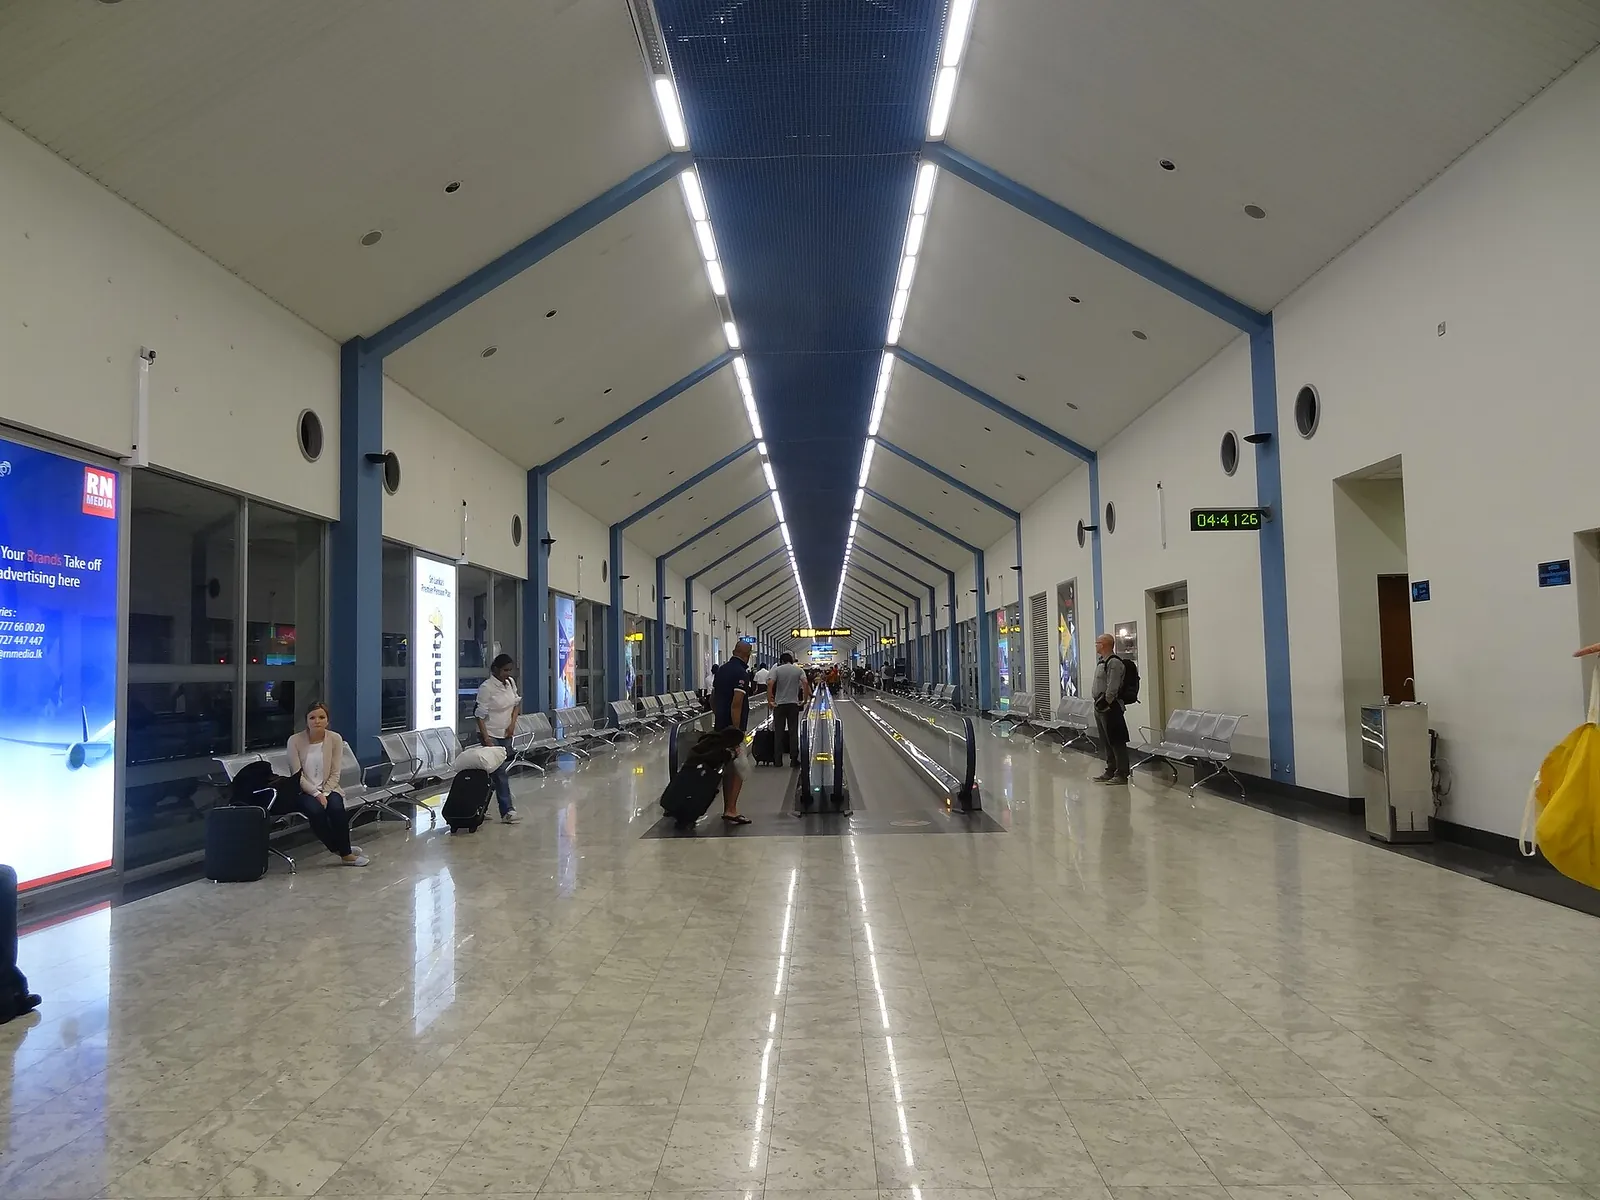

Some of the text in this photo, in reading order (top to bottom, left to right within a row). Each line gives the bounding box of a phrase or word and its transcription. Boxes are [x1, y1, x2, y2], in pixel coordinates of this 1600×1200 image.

[87, 472, 113, 499] RN
[86, 494, 113, 509] MEDIA
[0, 545, 102, 571] Your Brands Take off
[58, 573, 81, 587] here
[13, 635, 28, 645] 447
[29, 636, 44, 646] 447
[430, 624, 444, 721] infinity
